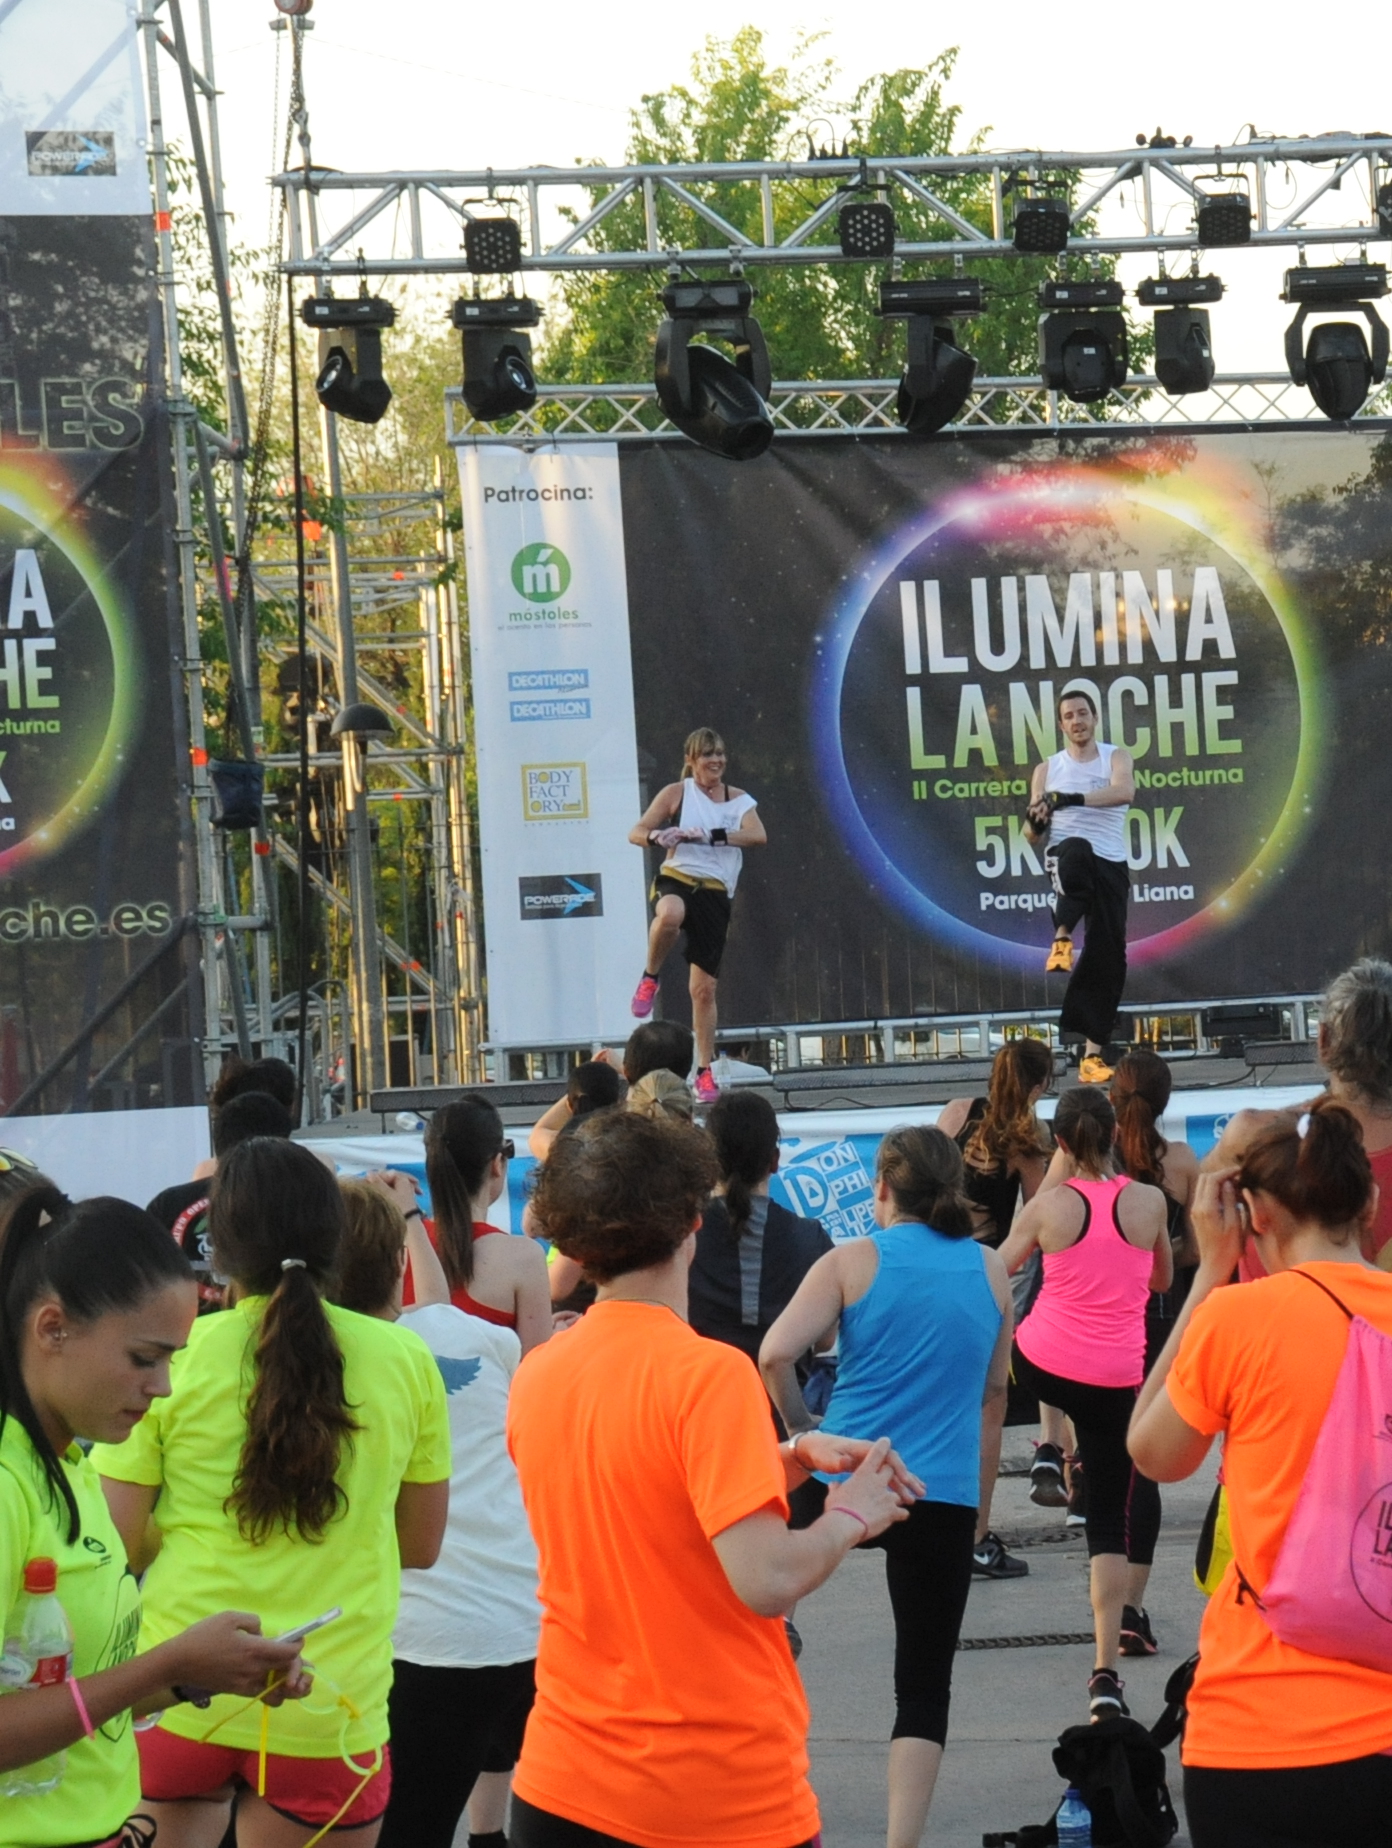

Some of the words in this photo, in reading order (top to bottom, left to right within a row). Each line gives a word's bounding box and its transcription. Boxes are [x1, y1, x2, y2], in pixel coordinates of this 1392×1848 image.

[484, 484, 593, 503] Patrocina:
[509, 607, 579, 622] móstoles
[900, 567, 1236, 675] ILUMINA
[512, 673, 584, 688] DECATHLON
[514, 702, 587, 717] DECATHLON
[906, 684, 999, 769] LA
[529, 770, 573, 785] BODY
[934, 778, 1027, 799] Carrera
[1134, 766, 1244, 789] Nocturna
[529, 785, 570, 799] FACT
[1124, 806, 1191, 871] 0K
[980, 890, 1058, 912] Parque
[1133, 884, 1195, 903] Liana
